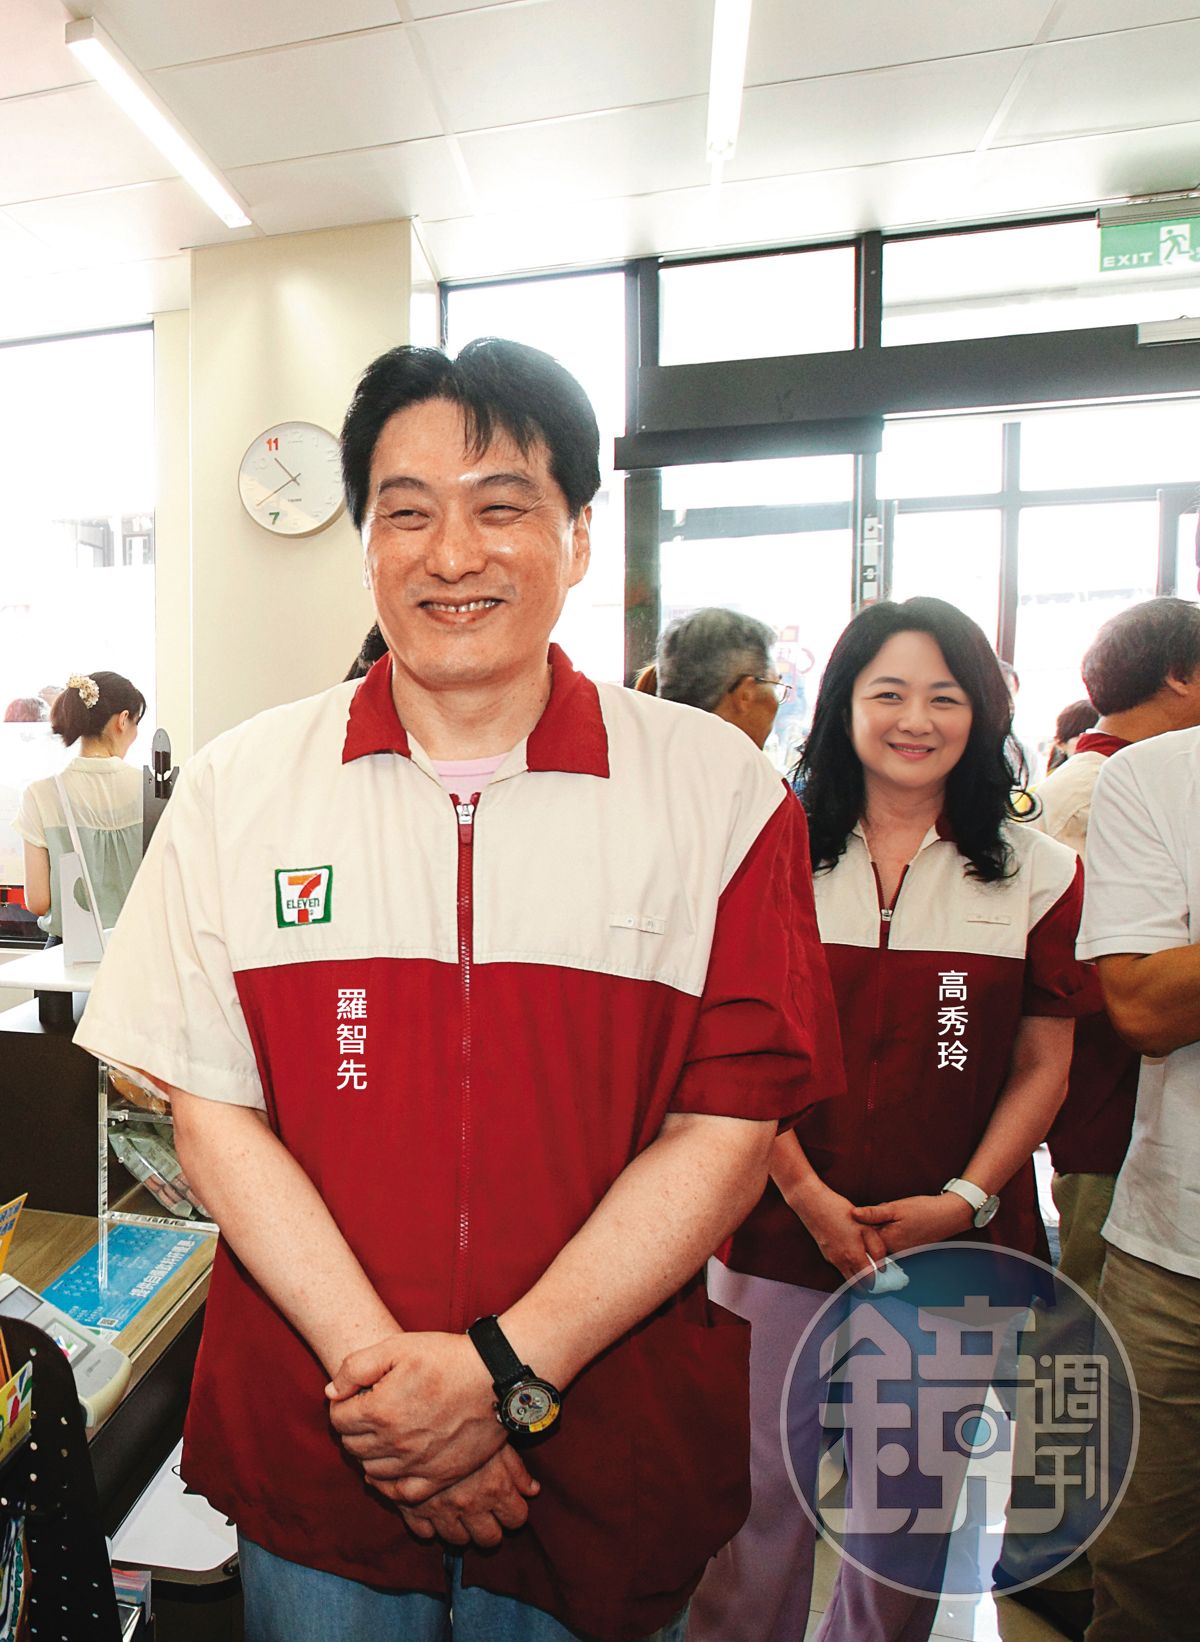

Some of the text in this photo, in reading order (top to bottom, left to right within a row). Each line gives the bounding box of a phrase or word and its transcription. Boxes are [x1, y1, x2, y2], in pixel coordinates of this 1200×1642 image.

[1103, 252, 1153, 267] EXIT
[266, 437, 279, 451] 11
[269, 512, 280, 525] 7
[286, 897, 321, 910] ELEVEN
